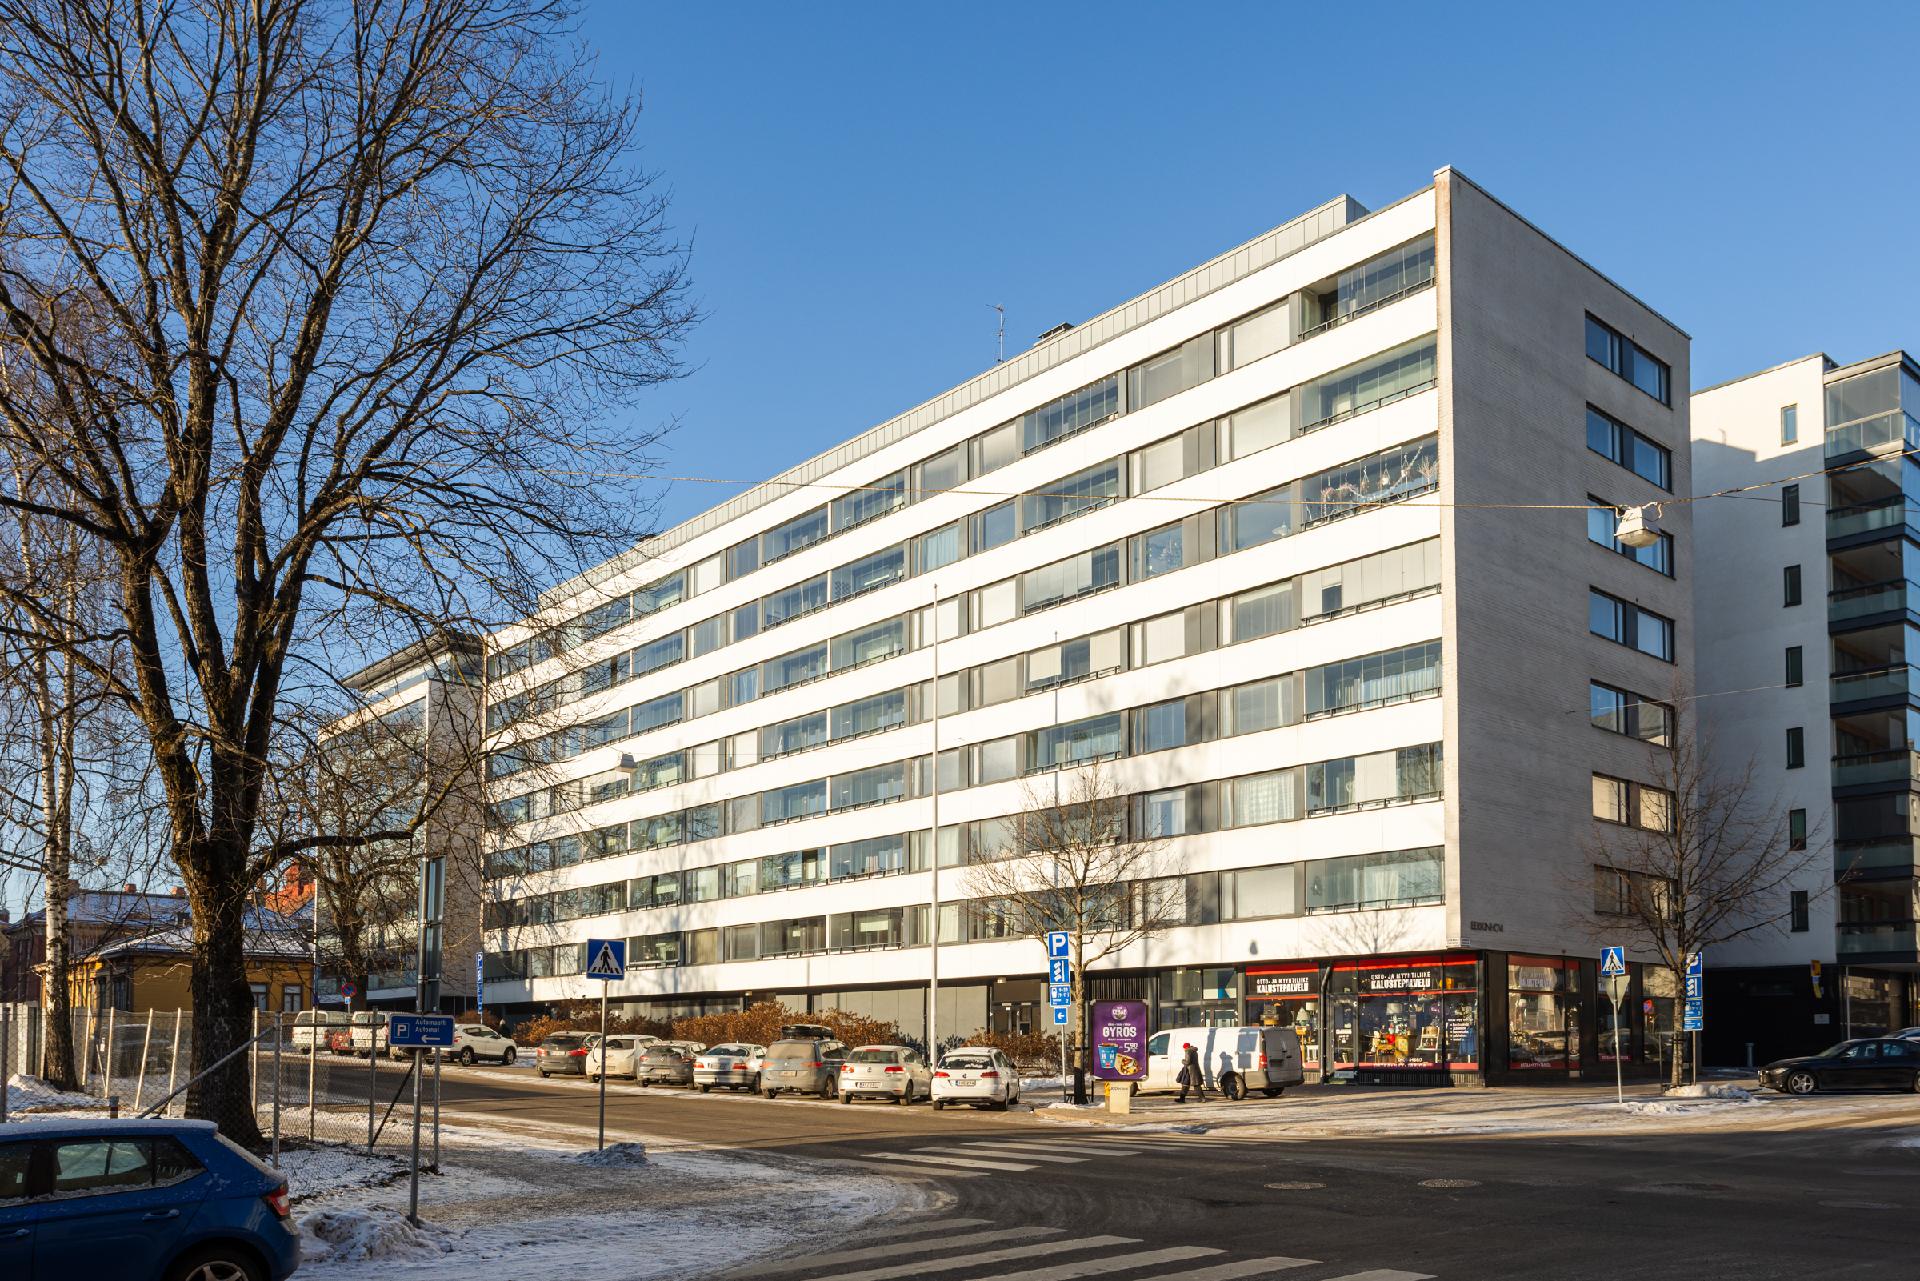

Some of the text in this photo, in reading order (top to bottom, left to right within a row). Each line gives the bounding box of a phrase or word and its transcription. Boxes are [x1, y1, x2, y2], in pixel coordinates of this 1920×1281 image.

[1051, 934, 1067, 956] P
[1256, 983, 1309, 994] KALUSTEPALVELU
[1370, 978, 1431, 990] KALUSTEPALVELU
[397, 1024, 407, 1037] P
[1102, 1026, 1137, 1038] GYROS
